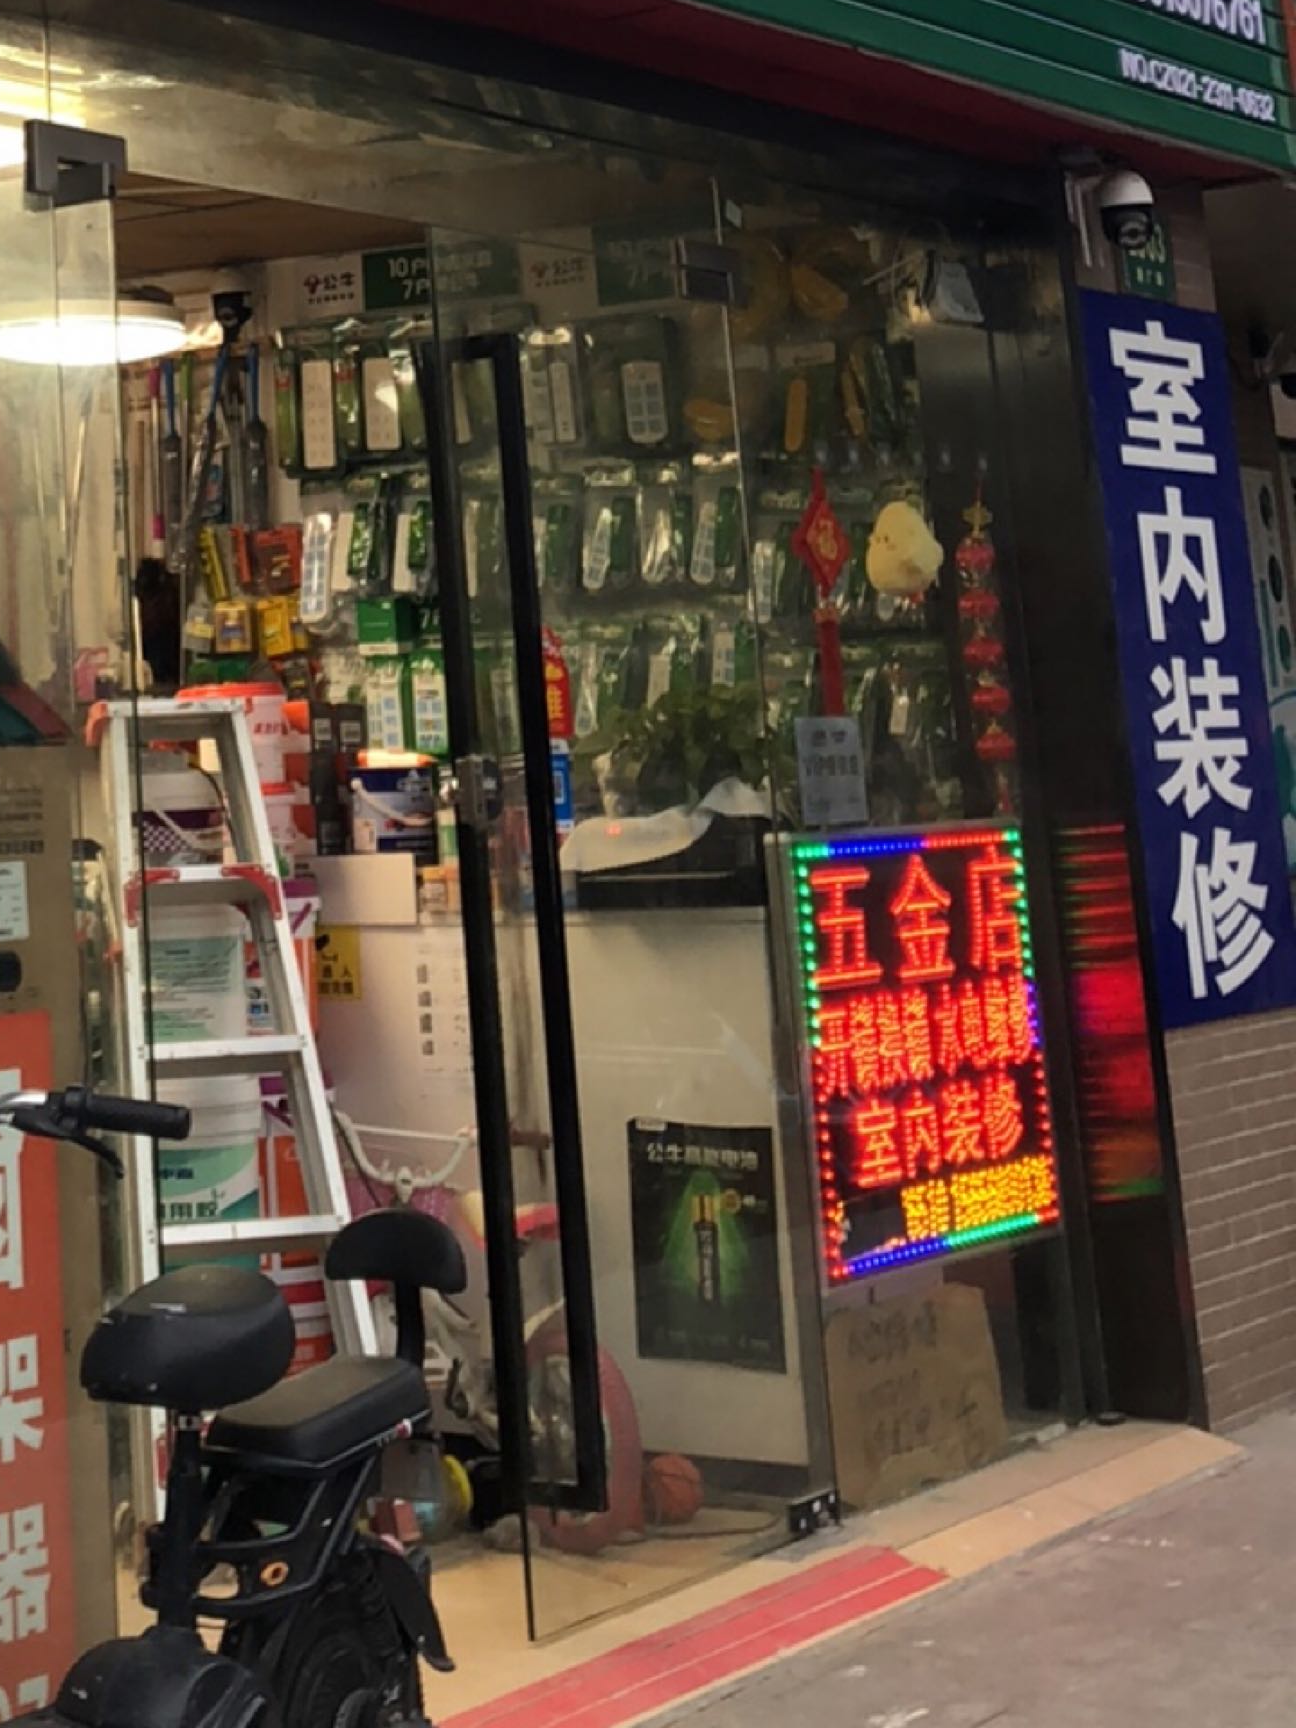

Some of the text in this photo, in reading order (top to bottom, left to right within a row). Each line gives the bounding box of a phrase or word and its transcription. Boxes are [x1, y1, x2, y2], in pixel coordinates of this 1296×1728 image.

[1108, 320, 1274, 999] 室内装修
[809, 845, 1022, 987] 五金店
[851, 1074, 1024, 1189] 室内装修
